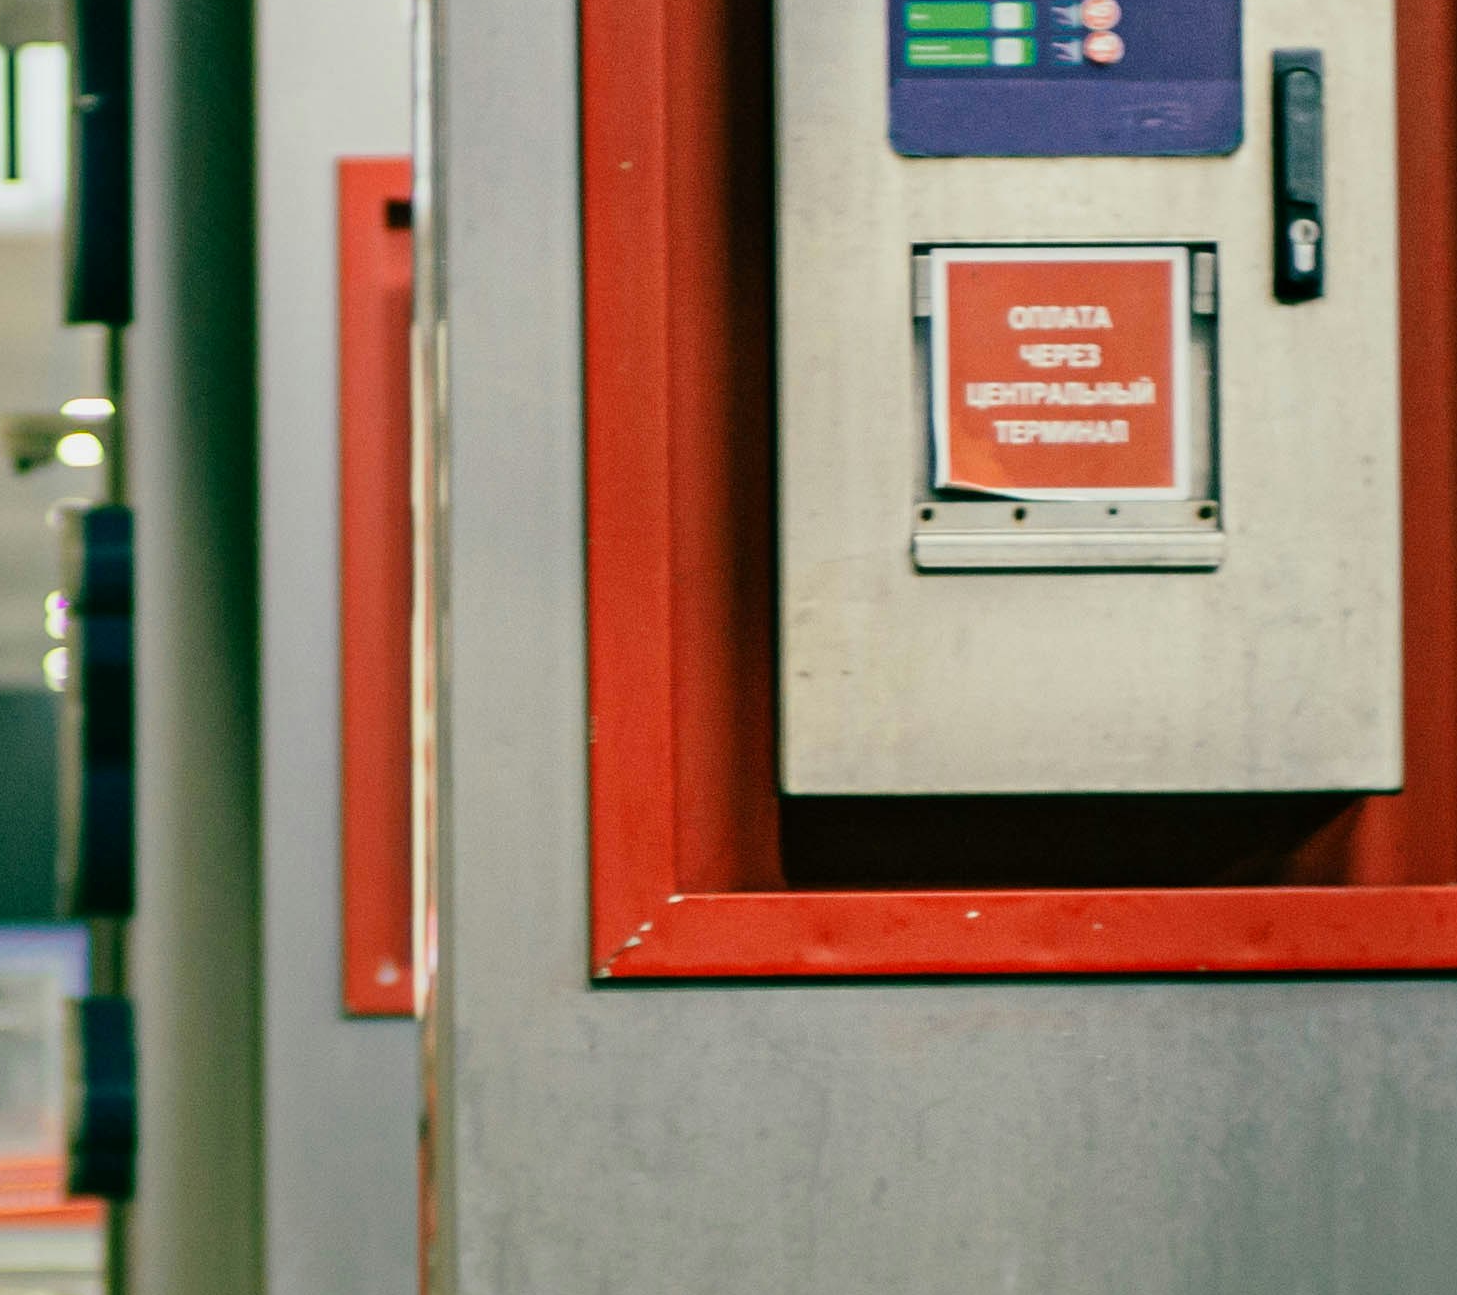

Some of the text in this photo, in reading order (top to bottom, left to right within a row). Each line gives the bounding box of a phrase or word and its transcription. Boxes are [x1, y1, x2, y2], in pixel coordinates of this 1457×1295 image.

[1007, 305, 1113, 331] ОПЛАТА
[1018, 343, 1102, 369] ЧЕРЕЗ
[965, 376, 1156, 410] ЦЕНТРАЛЬНЫЙ
[992, 419, 1130, 445] ТЕРМИНАЛ
